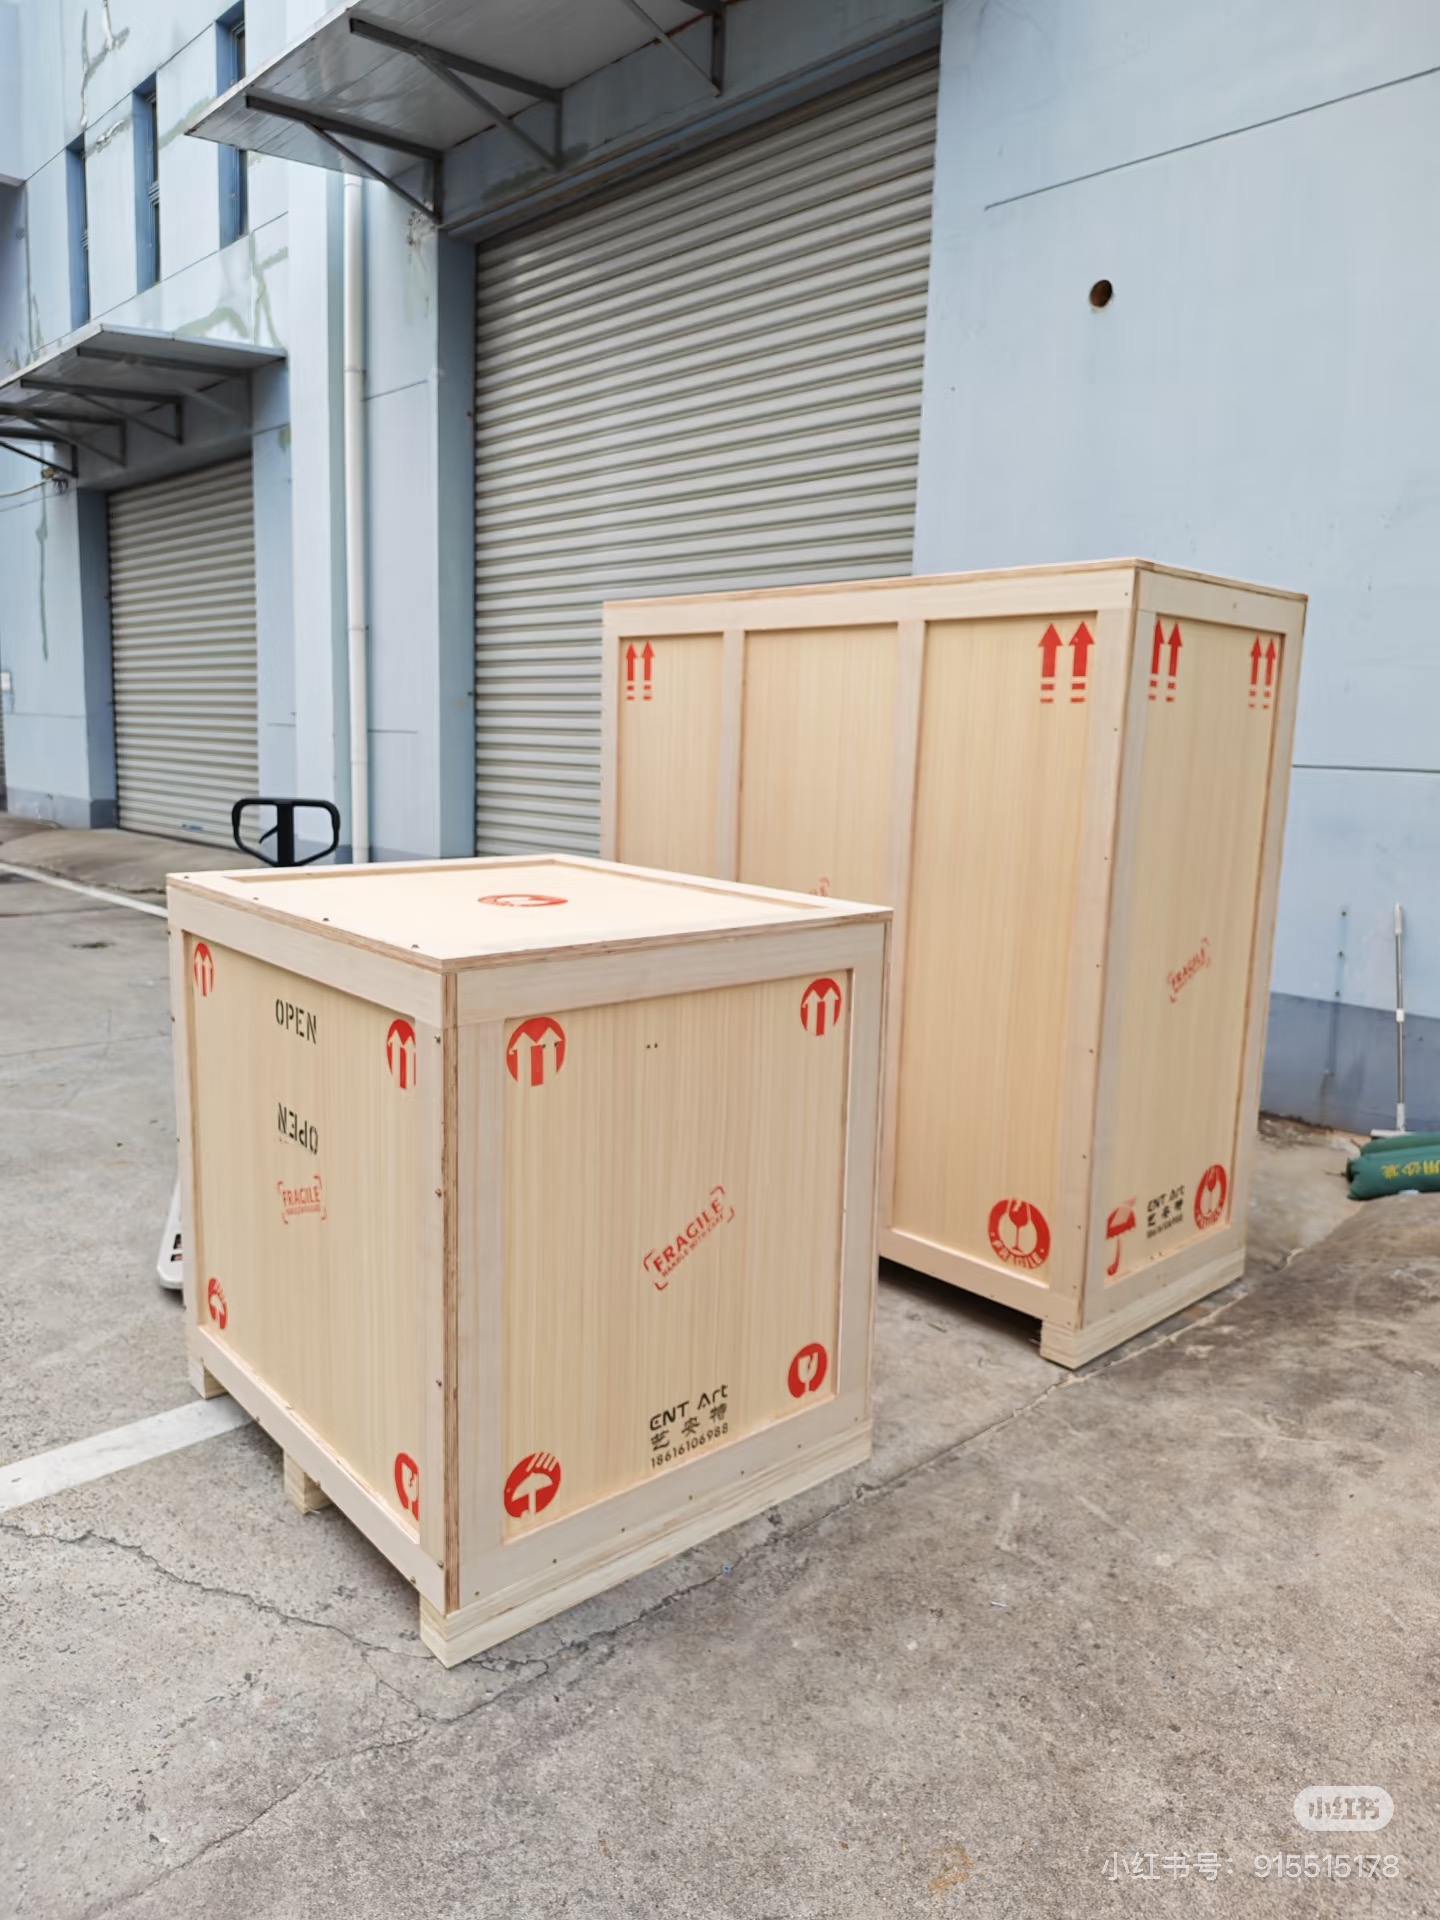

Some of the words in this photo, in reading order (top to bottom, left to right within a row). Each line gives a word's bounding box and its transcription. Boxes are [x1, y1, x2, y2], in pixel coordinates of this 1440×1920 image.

[275, 998, 318, 1045] OPEN
[277, 1102, 319, 1156] OPEN
[282, 1185, 321, 1206] FRAGILE
[653, 1198, 721, 1273] FRAGILE
[697, 1384, 729, 1410] Art
[651, 1422, 729, 1469] 18616106988
